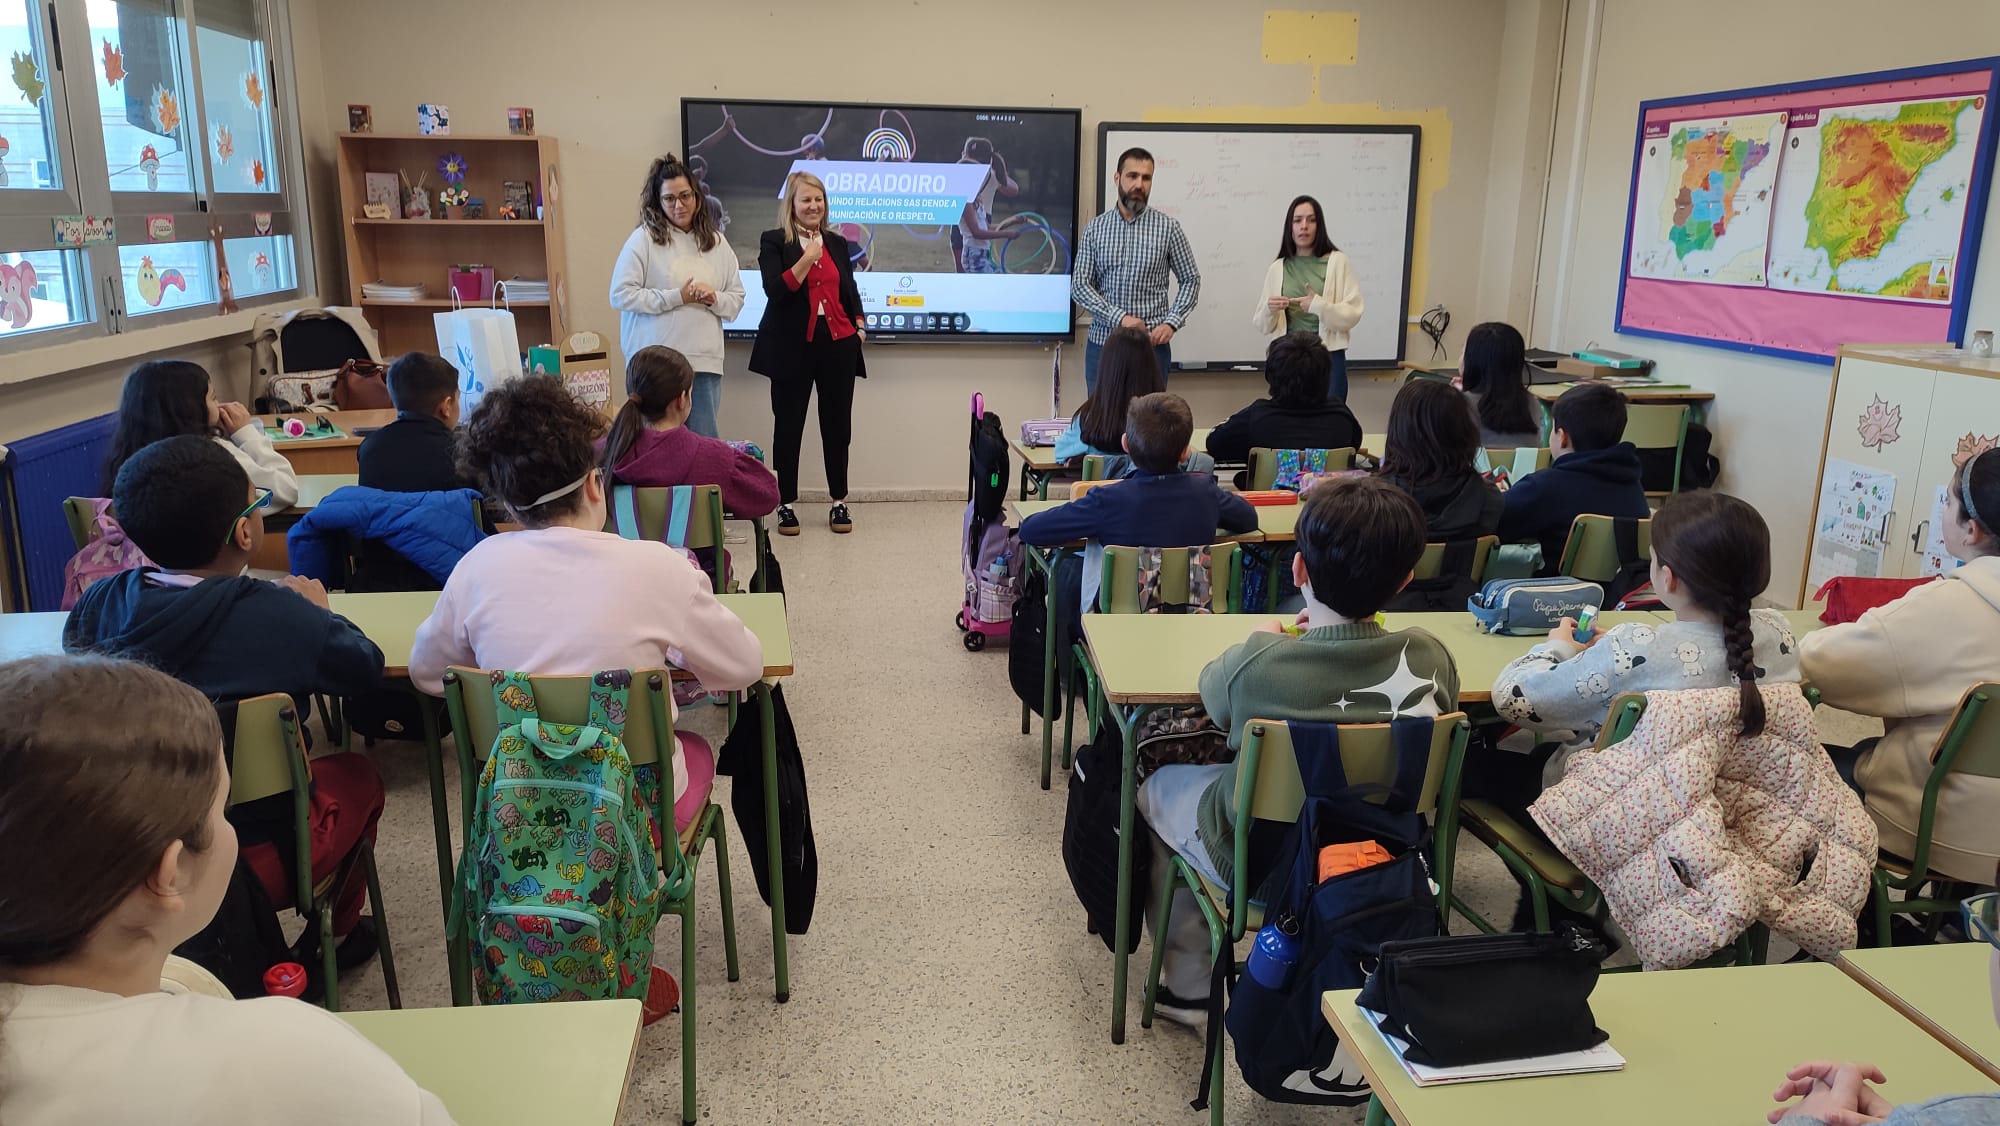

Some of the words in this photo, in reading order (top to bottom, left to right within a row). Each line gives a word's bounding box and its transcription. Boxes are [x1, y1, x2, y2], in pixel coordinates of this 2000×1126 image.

[824, 172, 947, 194] OBRADOIRO
[828, 195, 854, 206] UÍNDO
[855, 196, 902, 207] RELACIONS
[903, 198, 921, 207] SAS
[922, 199, 949, 208] DENDE
[951, 200, 957, 208] A
[829, 209, 881, 220] MUNICACIÓN
[881, 211, 887, 220] E
[888, 211, 895, 220] O
[895, 211, 936, 220] RESPETO.
[1533, 598, 1560, 616] Pepe
